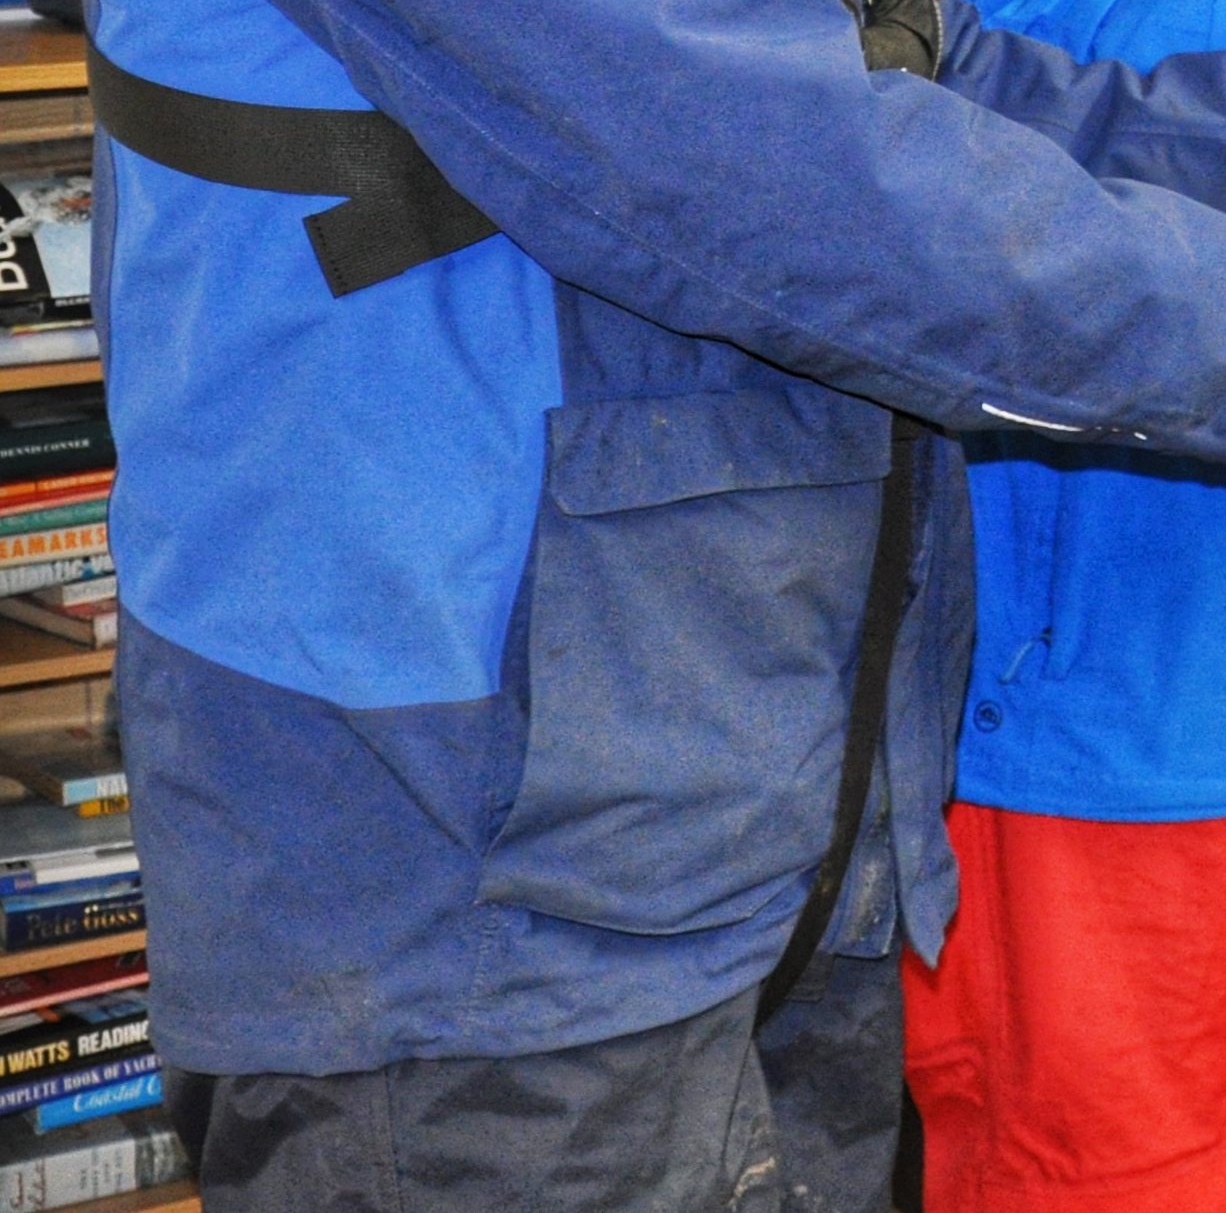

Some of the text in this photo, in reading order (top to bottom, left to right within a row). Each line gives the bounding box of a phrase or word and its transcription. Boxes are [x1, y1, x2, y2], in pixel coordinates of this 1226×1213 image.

[7, 1039, 70, 1075] WATTS
[63, 1070, 100, 1093] BOOK
[103, 1062, 120, 1080] OF
